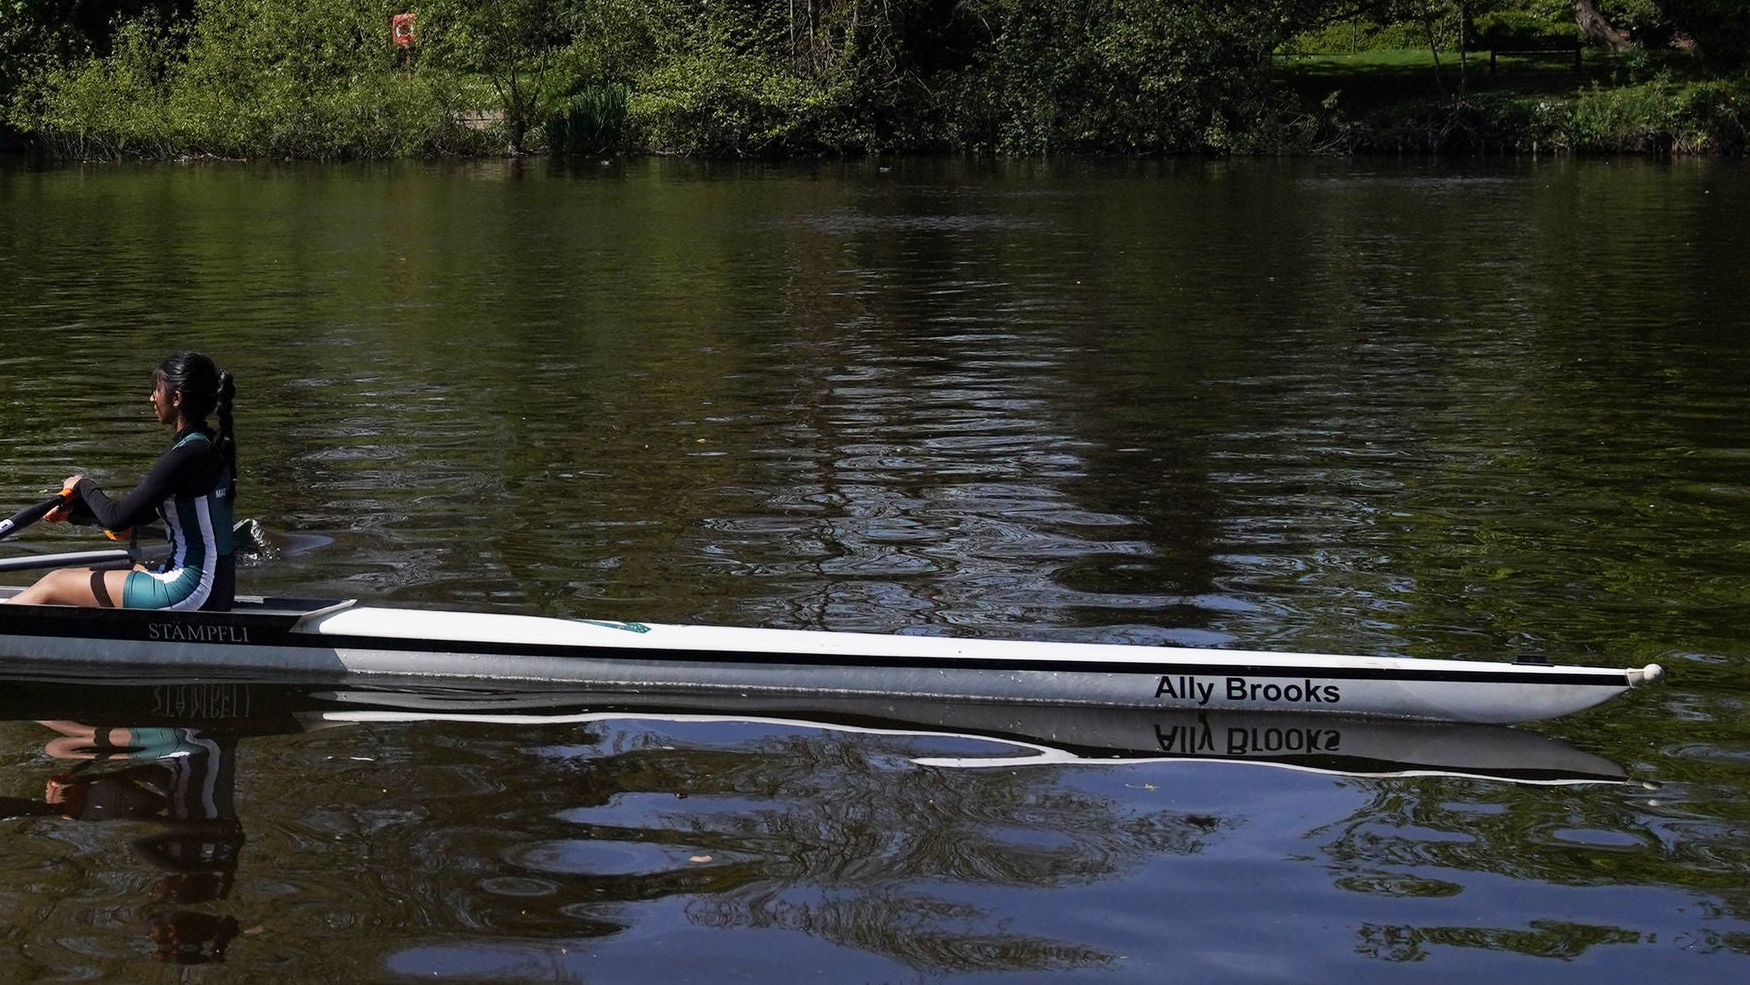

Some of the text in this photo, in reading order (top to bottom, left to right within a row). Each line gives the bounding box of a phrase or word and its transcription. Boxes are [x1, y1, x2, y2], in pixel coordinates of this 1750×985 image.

[148, 620, 250, 643] STÄMPFLI
[1154, 675, 1340, 705] Ally Brooks
